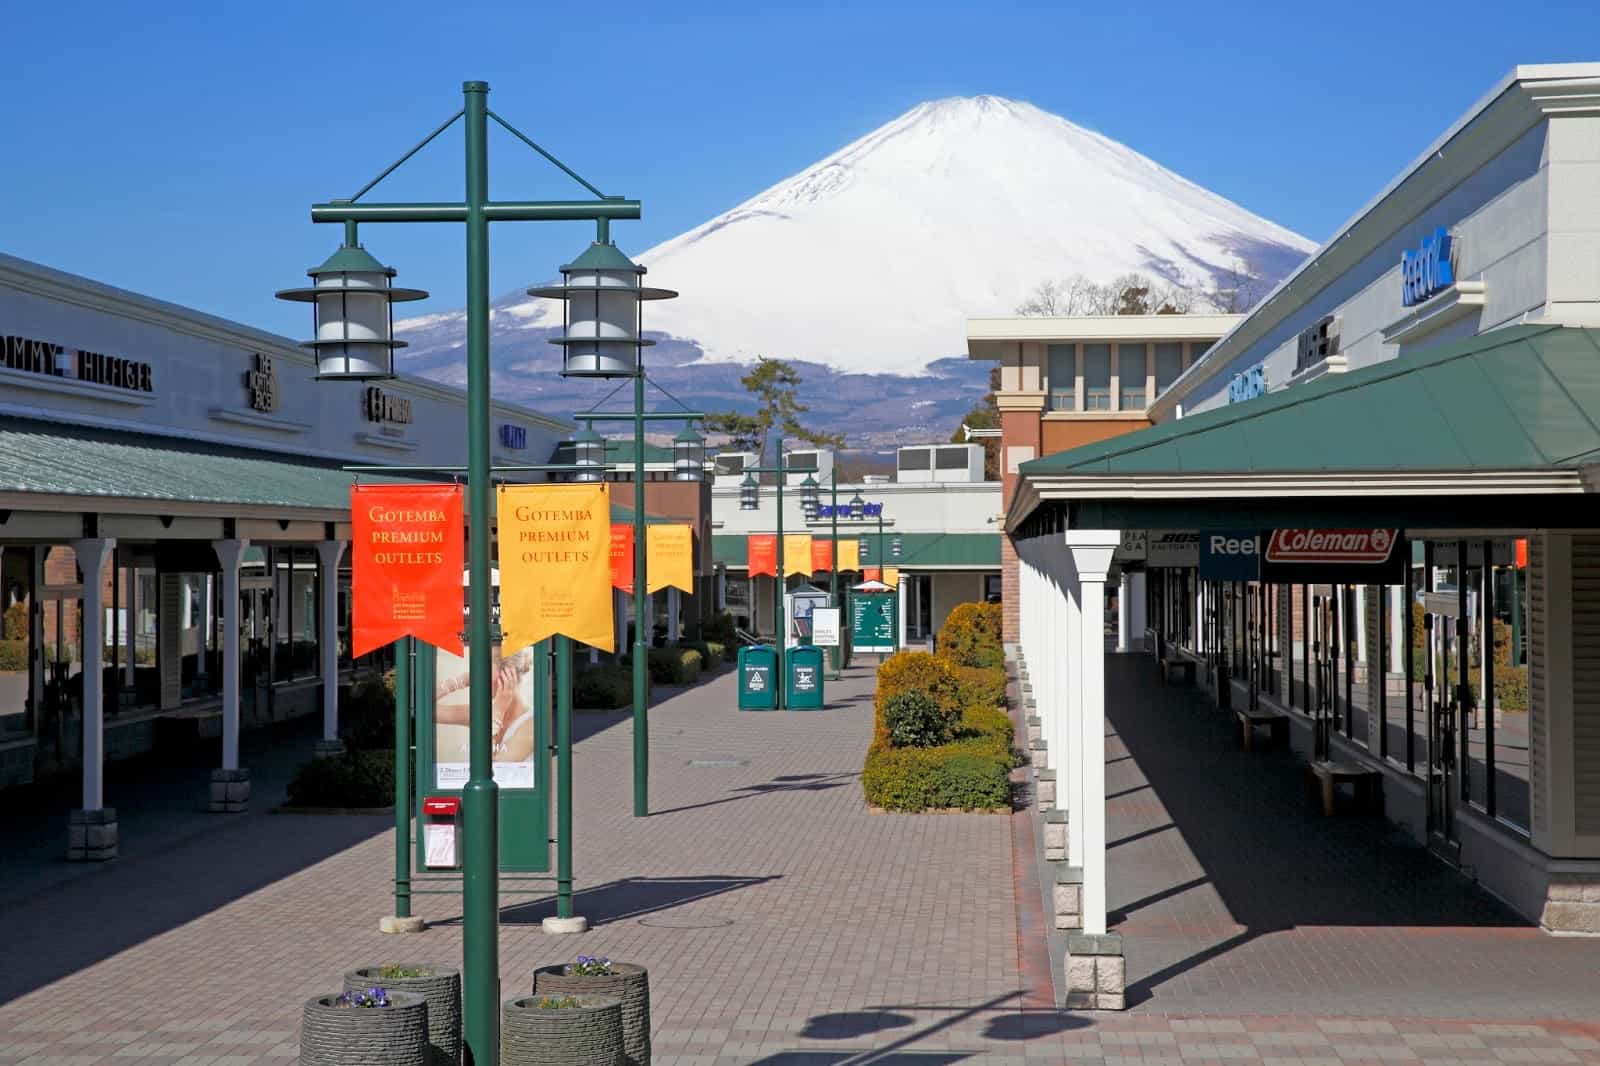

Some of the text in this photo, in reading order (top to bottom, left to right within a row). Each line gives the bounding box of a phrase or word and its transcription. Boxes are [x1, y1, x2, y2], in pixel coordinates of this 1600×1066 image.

[78, 350, 152, 392] HILFIGER
[372, 531, 443, 544] PREMIUM
[519, 530, 590, 543] PREMIUM
[1279, 529, 1369, 552] Coleman
[375, 552, 443, 564] OUTLETS
[522, 551, 589, 563] OUTLETS
